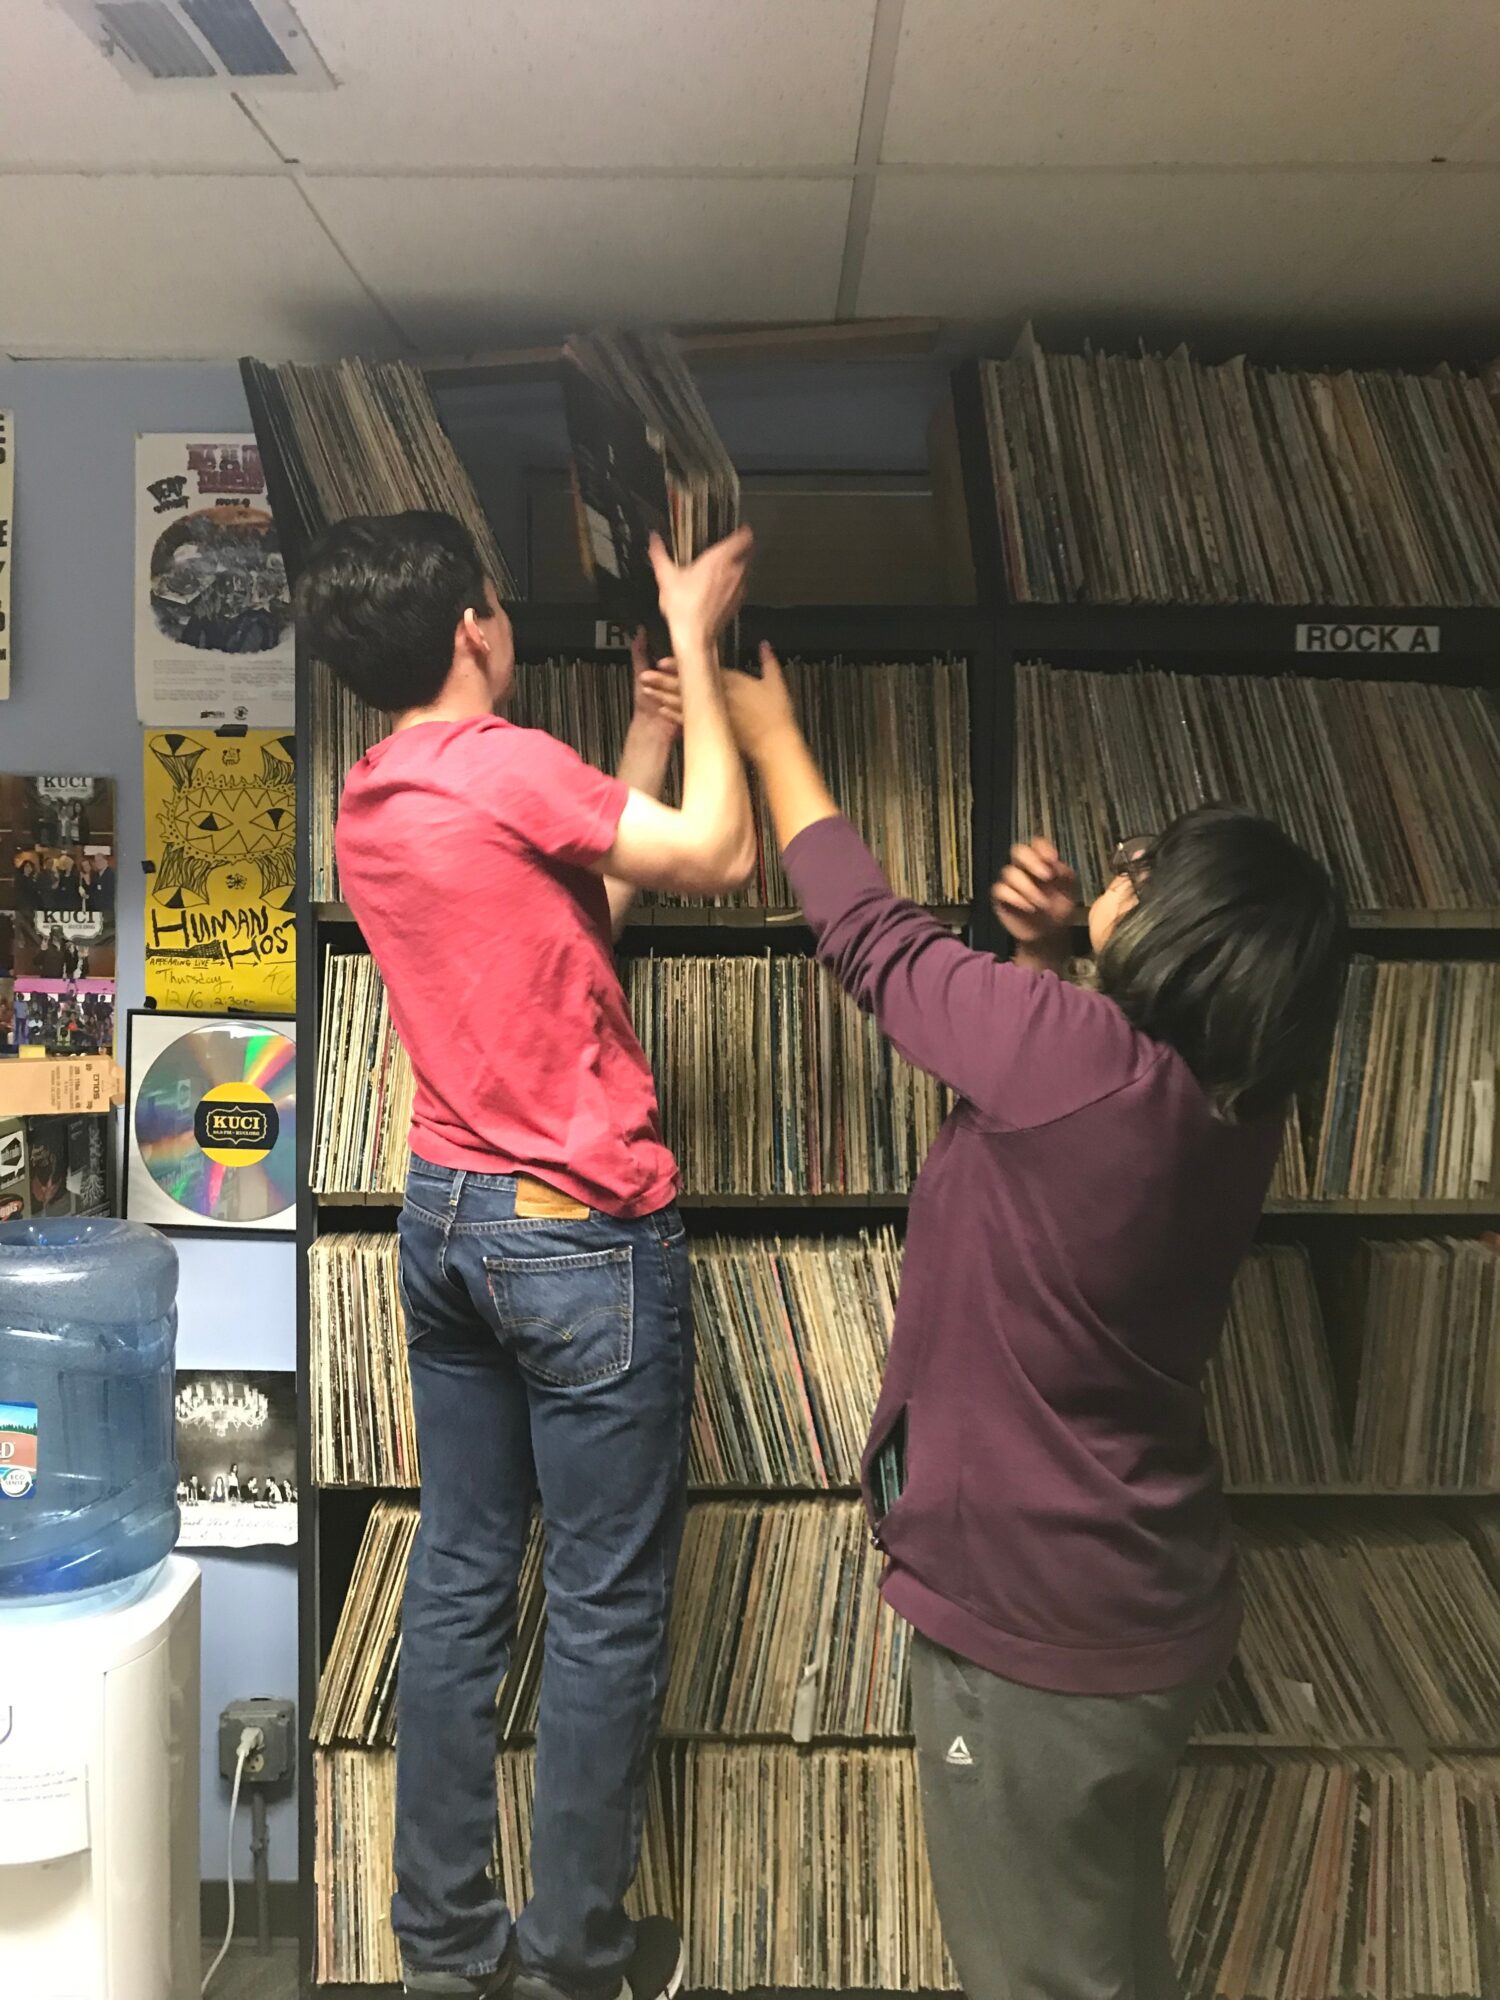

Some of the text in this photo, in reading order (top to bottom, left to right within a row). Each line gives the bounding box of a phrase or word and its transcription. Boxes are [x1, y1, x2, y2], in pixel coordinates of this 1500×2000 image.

[1306, 625, 1432, 651] ROCK A
[44, 776, 88, 788] KUCI
[43, 911, 96, 924] KUCI
[152, 905, 268, 948] HUMAN
[213, 1115, 260, 1130] KUCI
